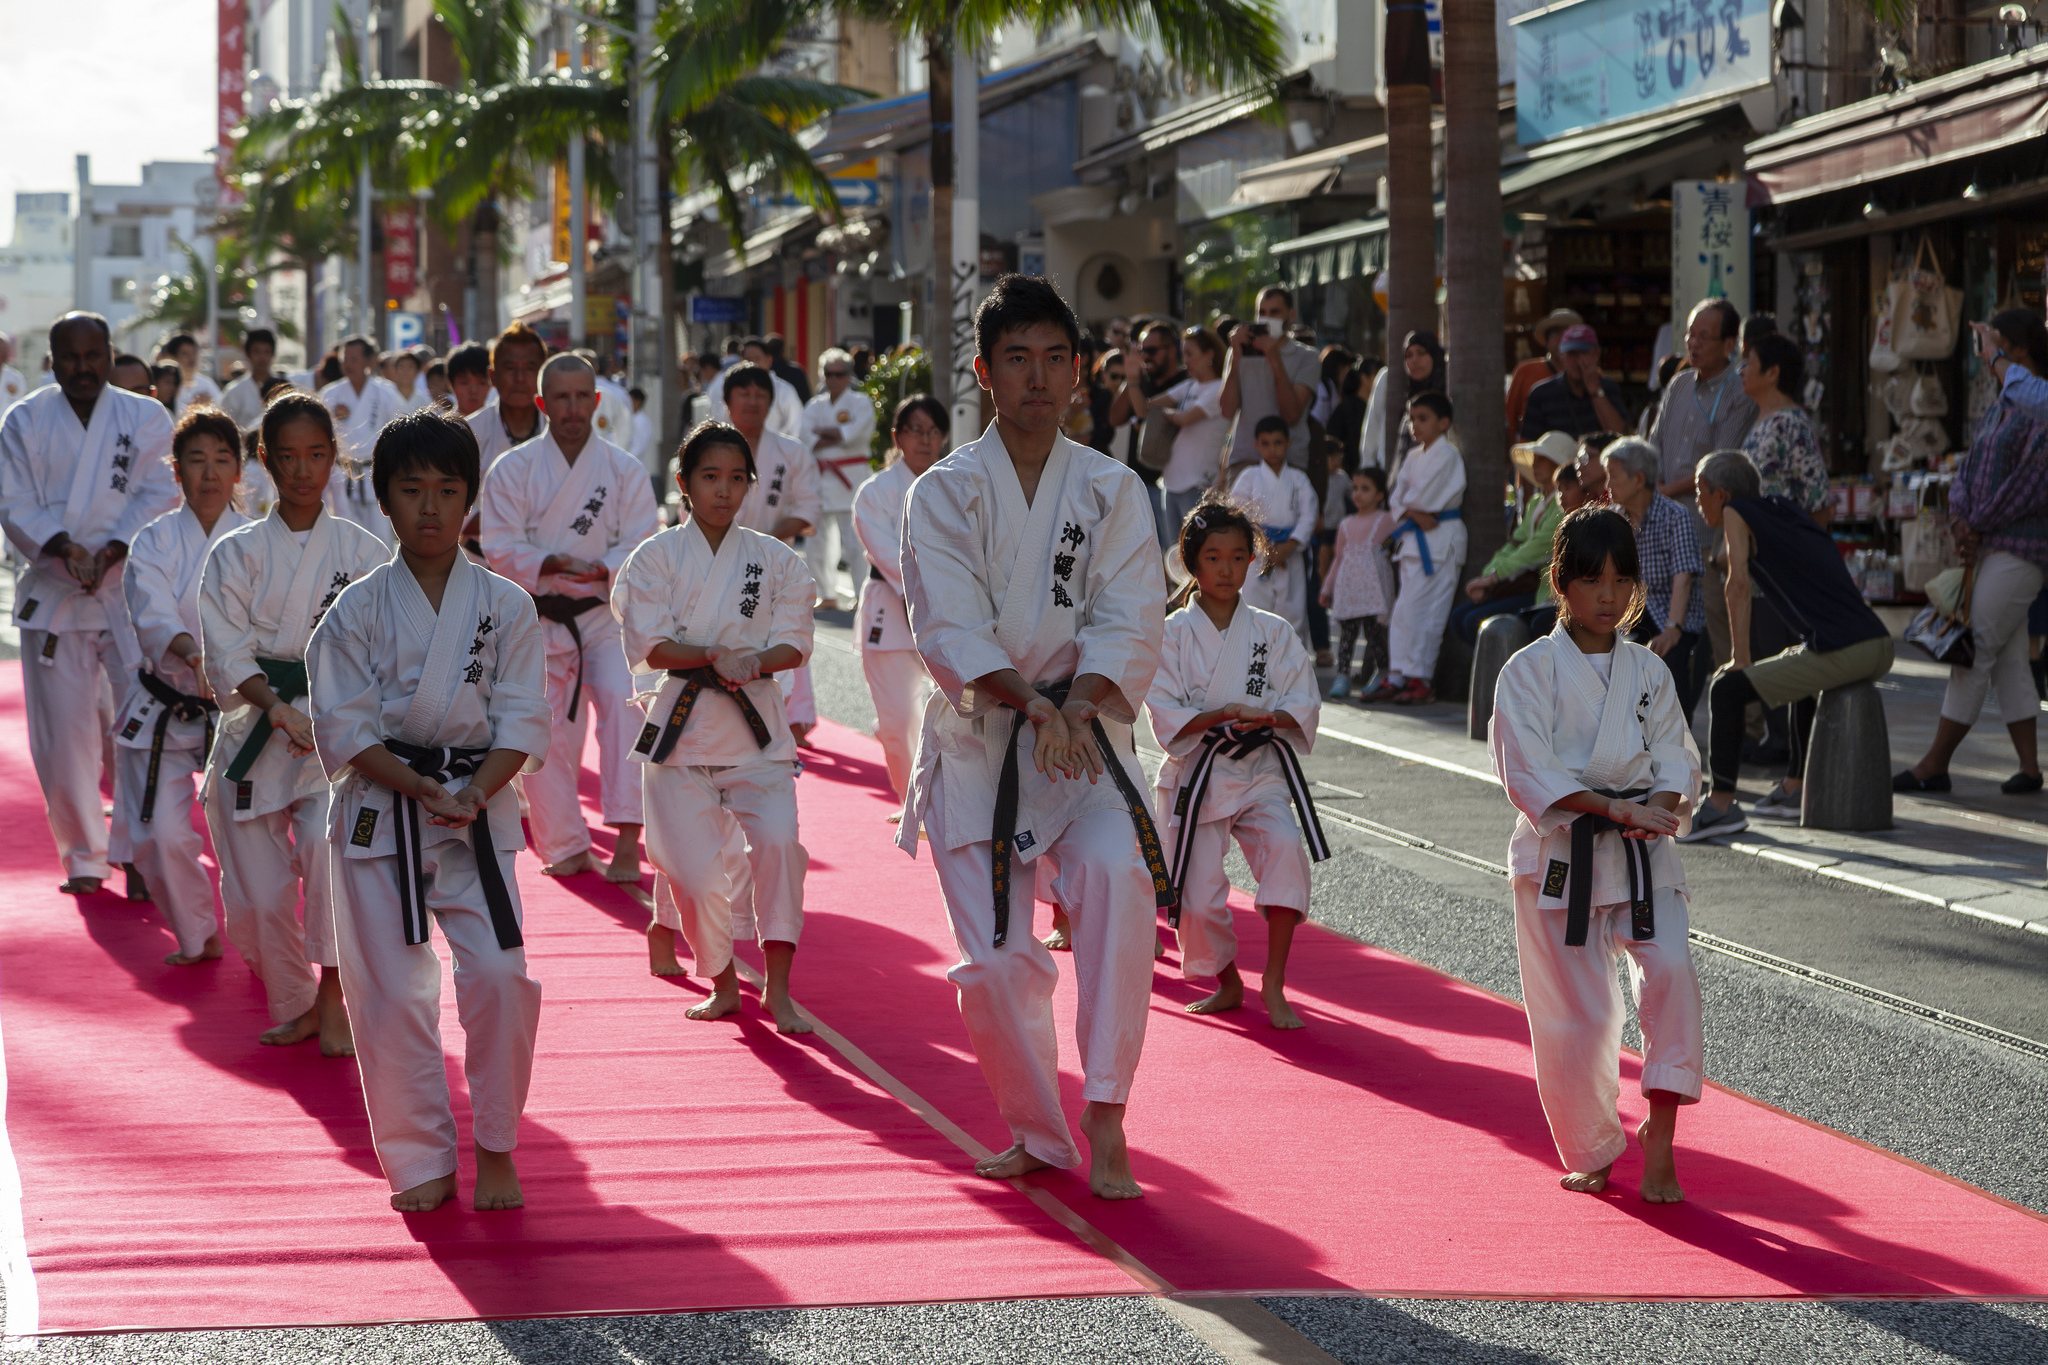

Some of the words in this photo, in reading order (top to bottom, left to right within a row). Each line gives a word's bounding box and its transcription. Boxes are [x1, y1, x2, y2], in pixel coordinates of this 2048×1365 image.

[1703, 188, 1733, 249] 青桜
[393, 315, 424, 352] P
[739, 562, 764, 619] 沖縄館
[1051, 521, 1086, 608] 沖縄館
[1246, 642, 1268, 698] 沖縄館
